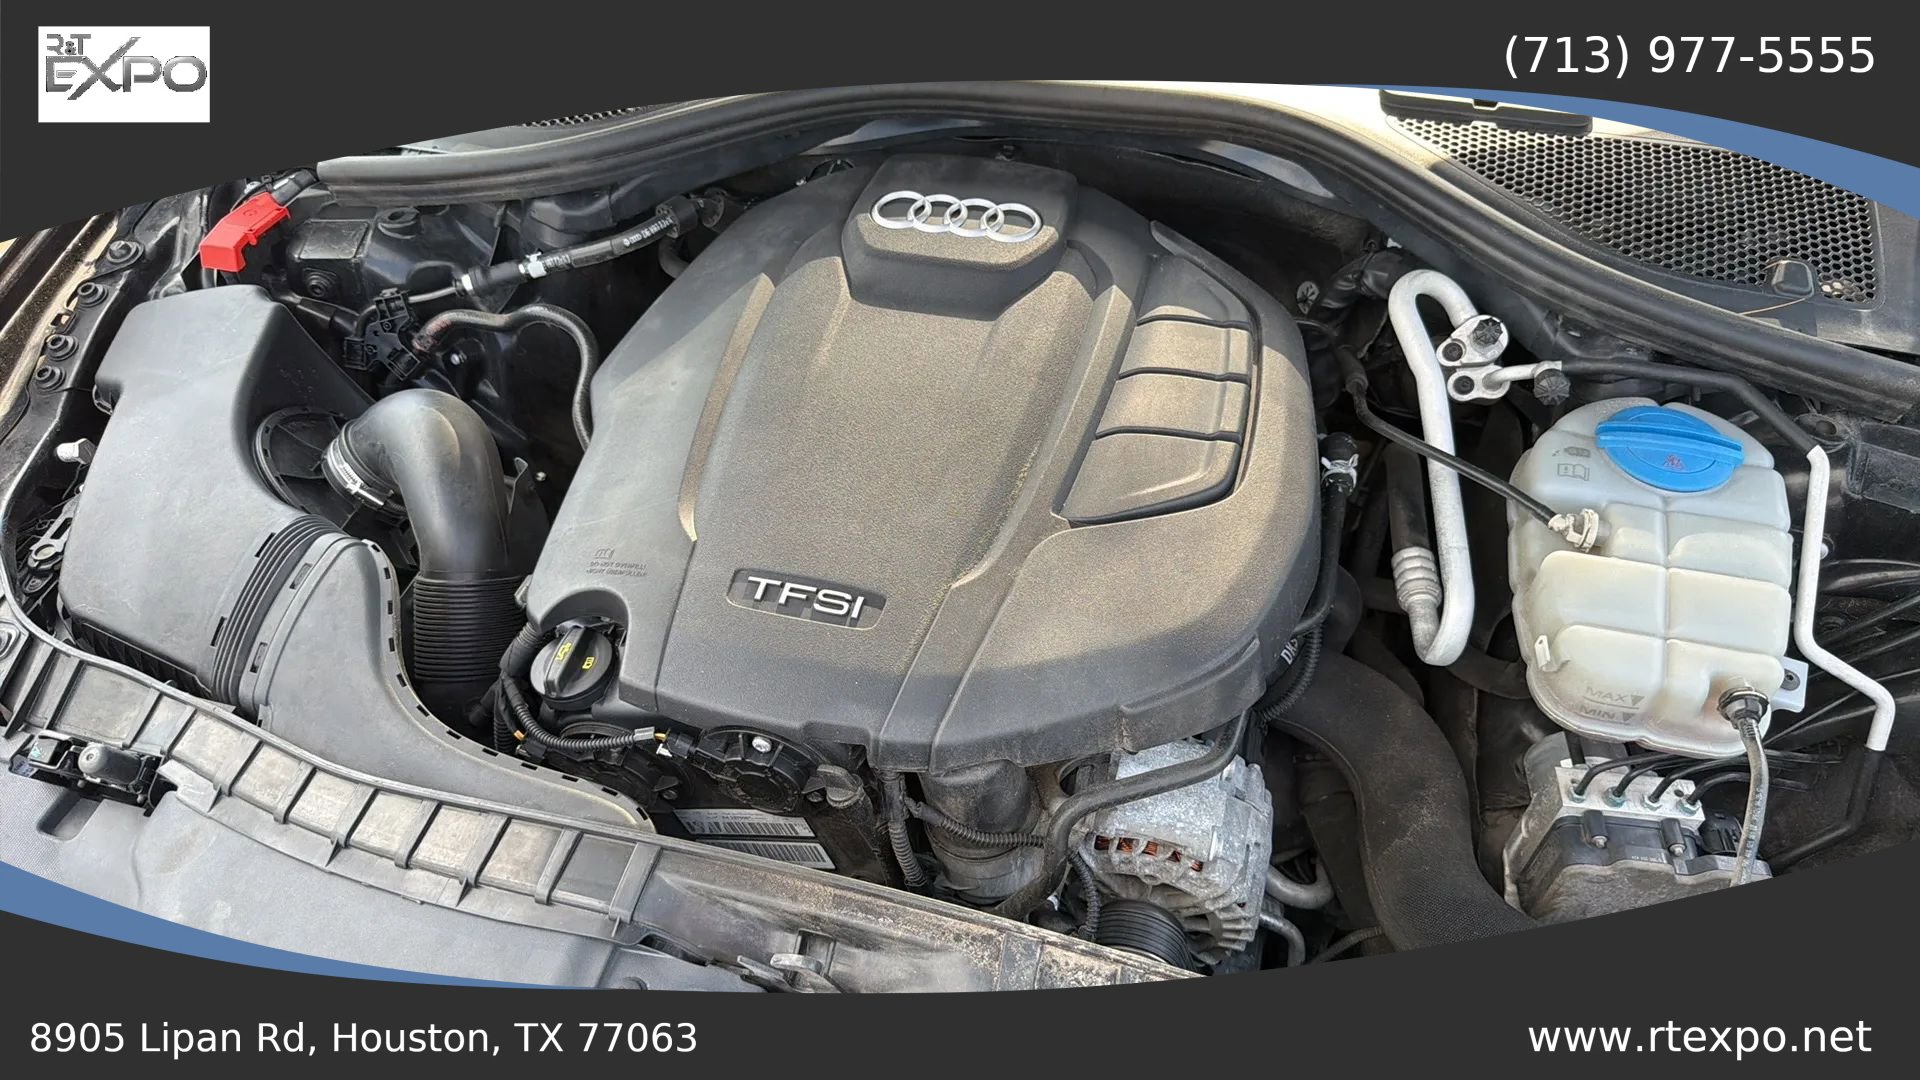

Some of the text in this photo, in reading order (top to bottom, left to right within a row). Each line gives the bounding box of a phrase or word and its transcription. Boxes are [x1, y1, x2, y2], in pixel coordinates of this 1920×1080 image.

[747, 575, 866, 619] TFSI
[1586, 686, 1627, 703] MAX
[1579, 704, 1616, 720] MIN
